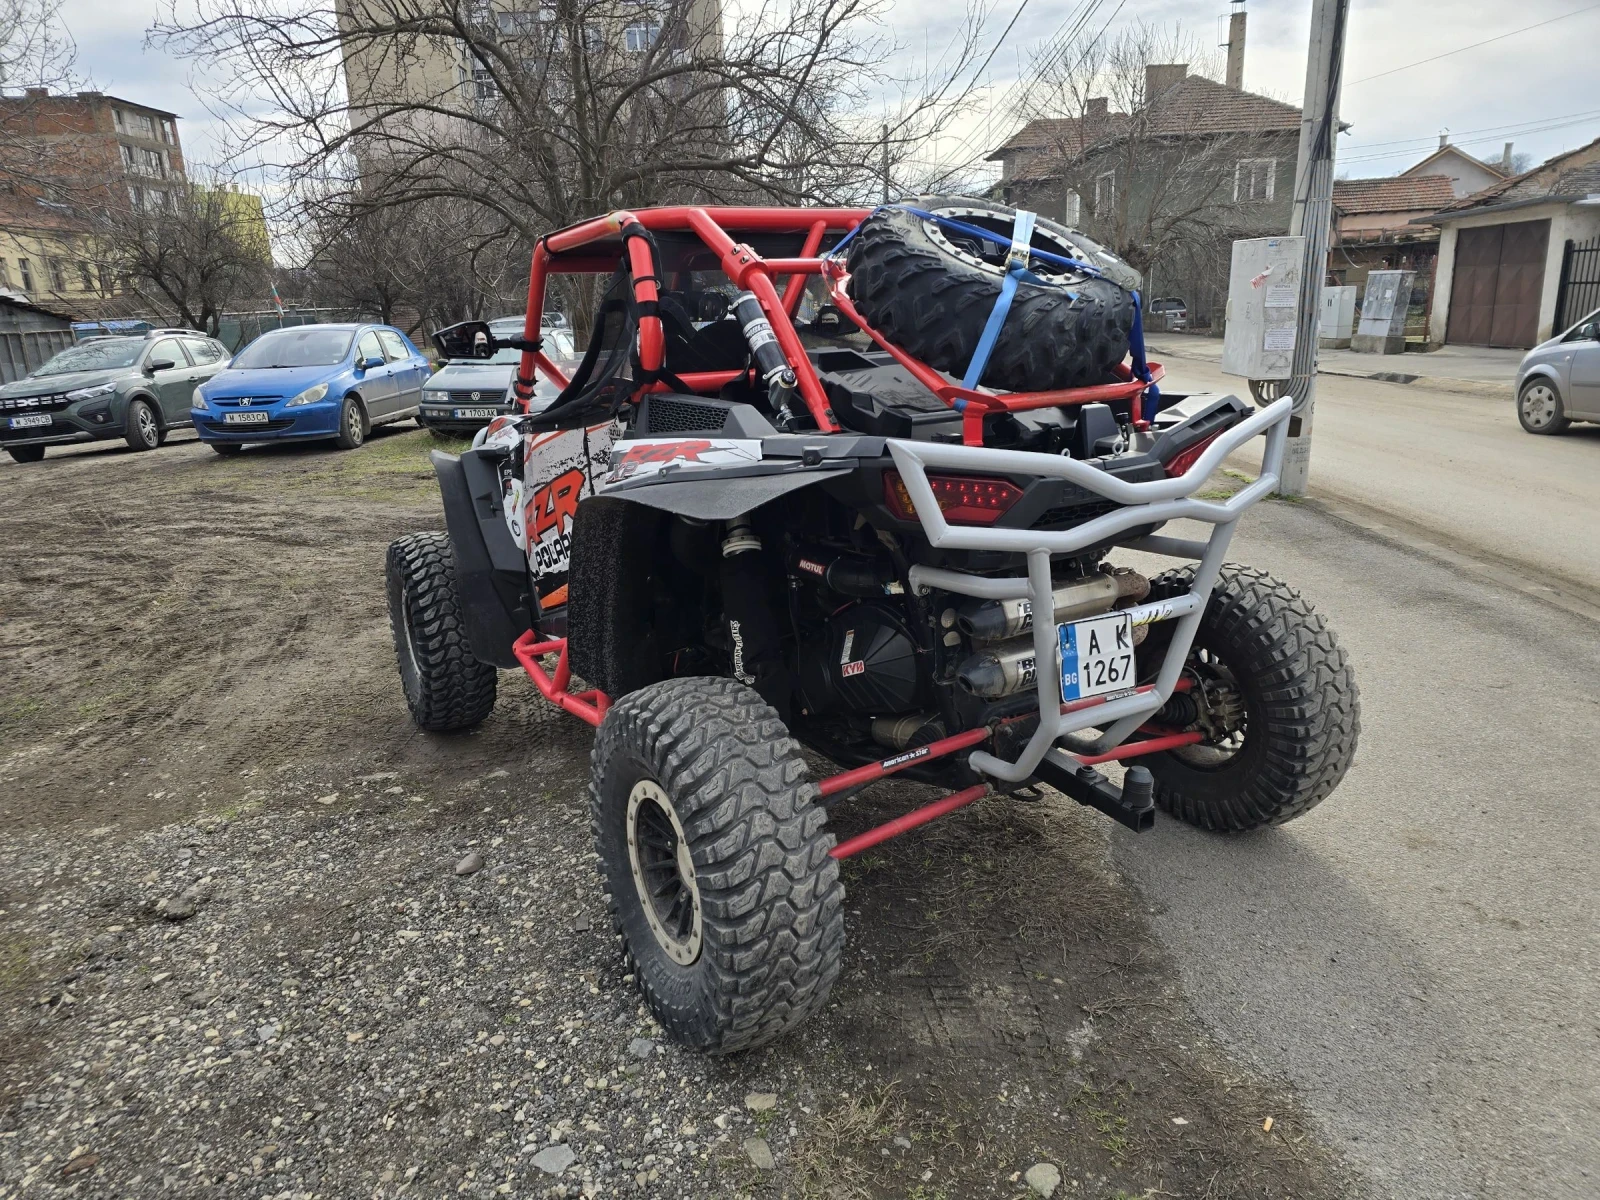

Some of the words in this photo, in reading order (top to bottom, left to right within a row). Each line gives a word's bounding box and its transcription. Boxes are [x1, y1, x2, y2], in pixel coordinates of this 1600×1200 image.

[256, 413, 267, 421] CA
[487, 409, 496, 417] AK
[622, 440, 712, 464] RZR
[525, 469, 586, 560] RZR
[799, 560, 823, 575] MOTUL
[1089, 629, 1101, 656] A
[1115, 624, 1130, 650] K
[1064, 673, 1078, 686] BG
[1083, 654, 1131, 688] 1267
